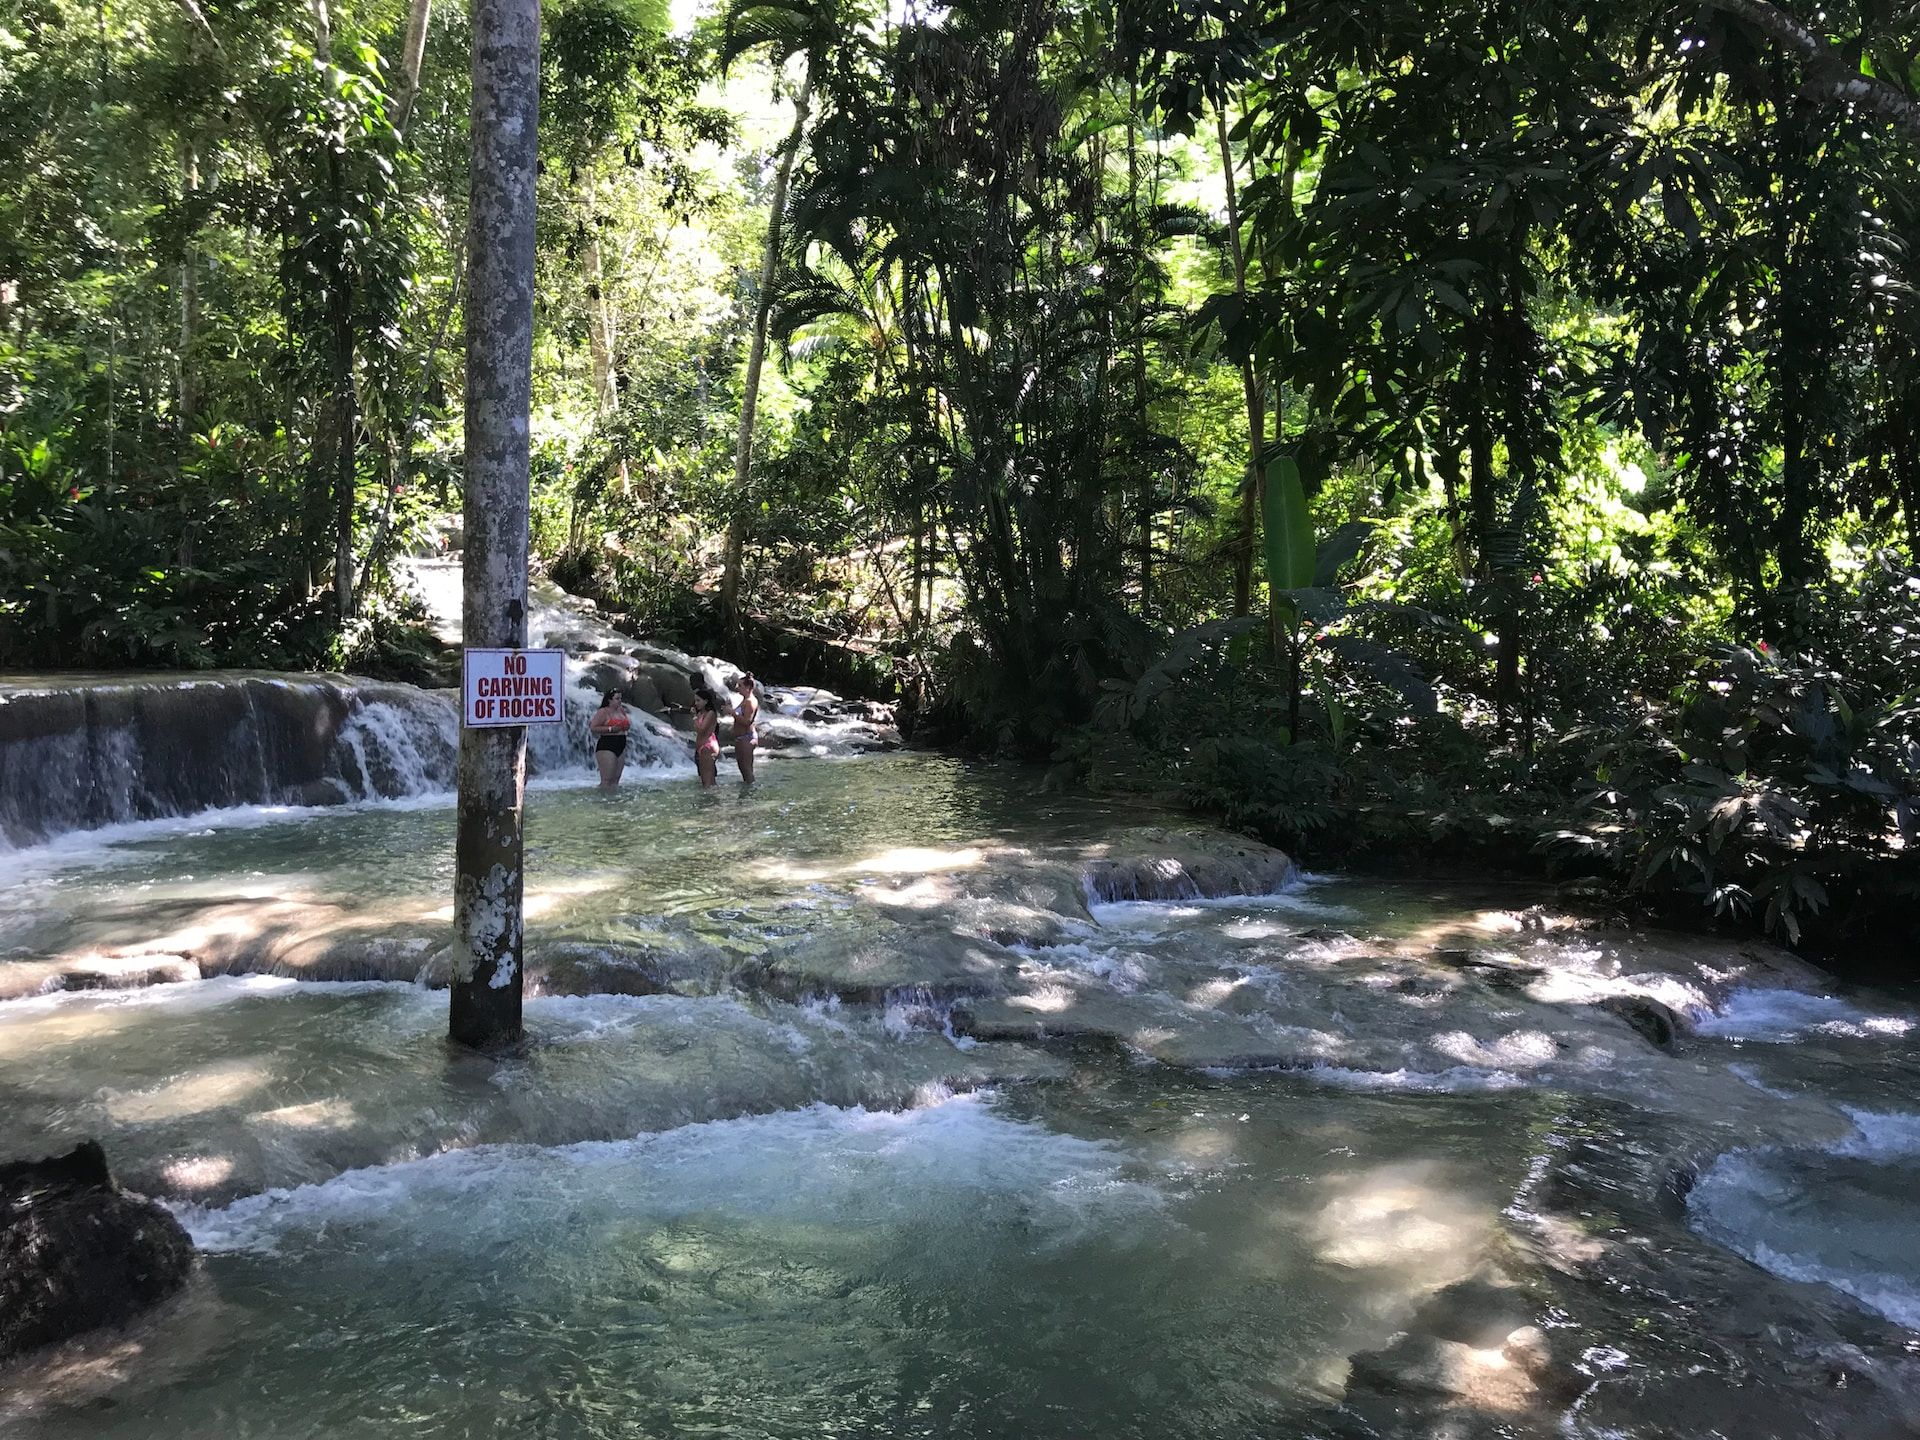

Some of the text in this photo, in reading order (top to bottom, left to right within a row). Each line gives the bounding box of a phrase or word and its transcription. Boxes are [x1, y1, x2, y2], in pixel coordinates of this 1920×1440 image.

[504, 656, 527, 675] NO
[478, 677, 552, 697] CARVING
[475, 698, 556, 718] OF ROCKS
